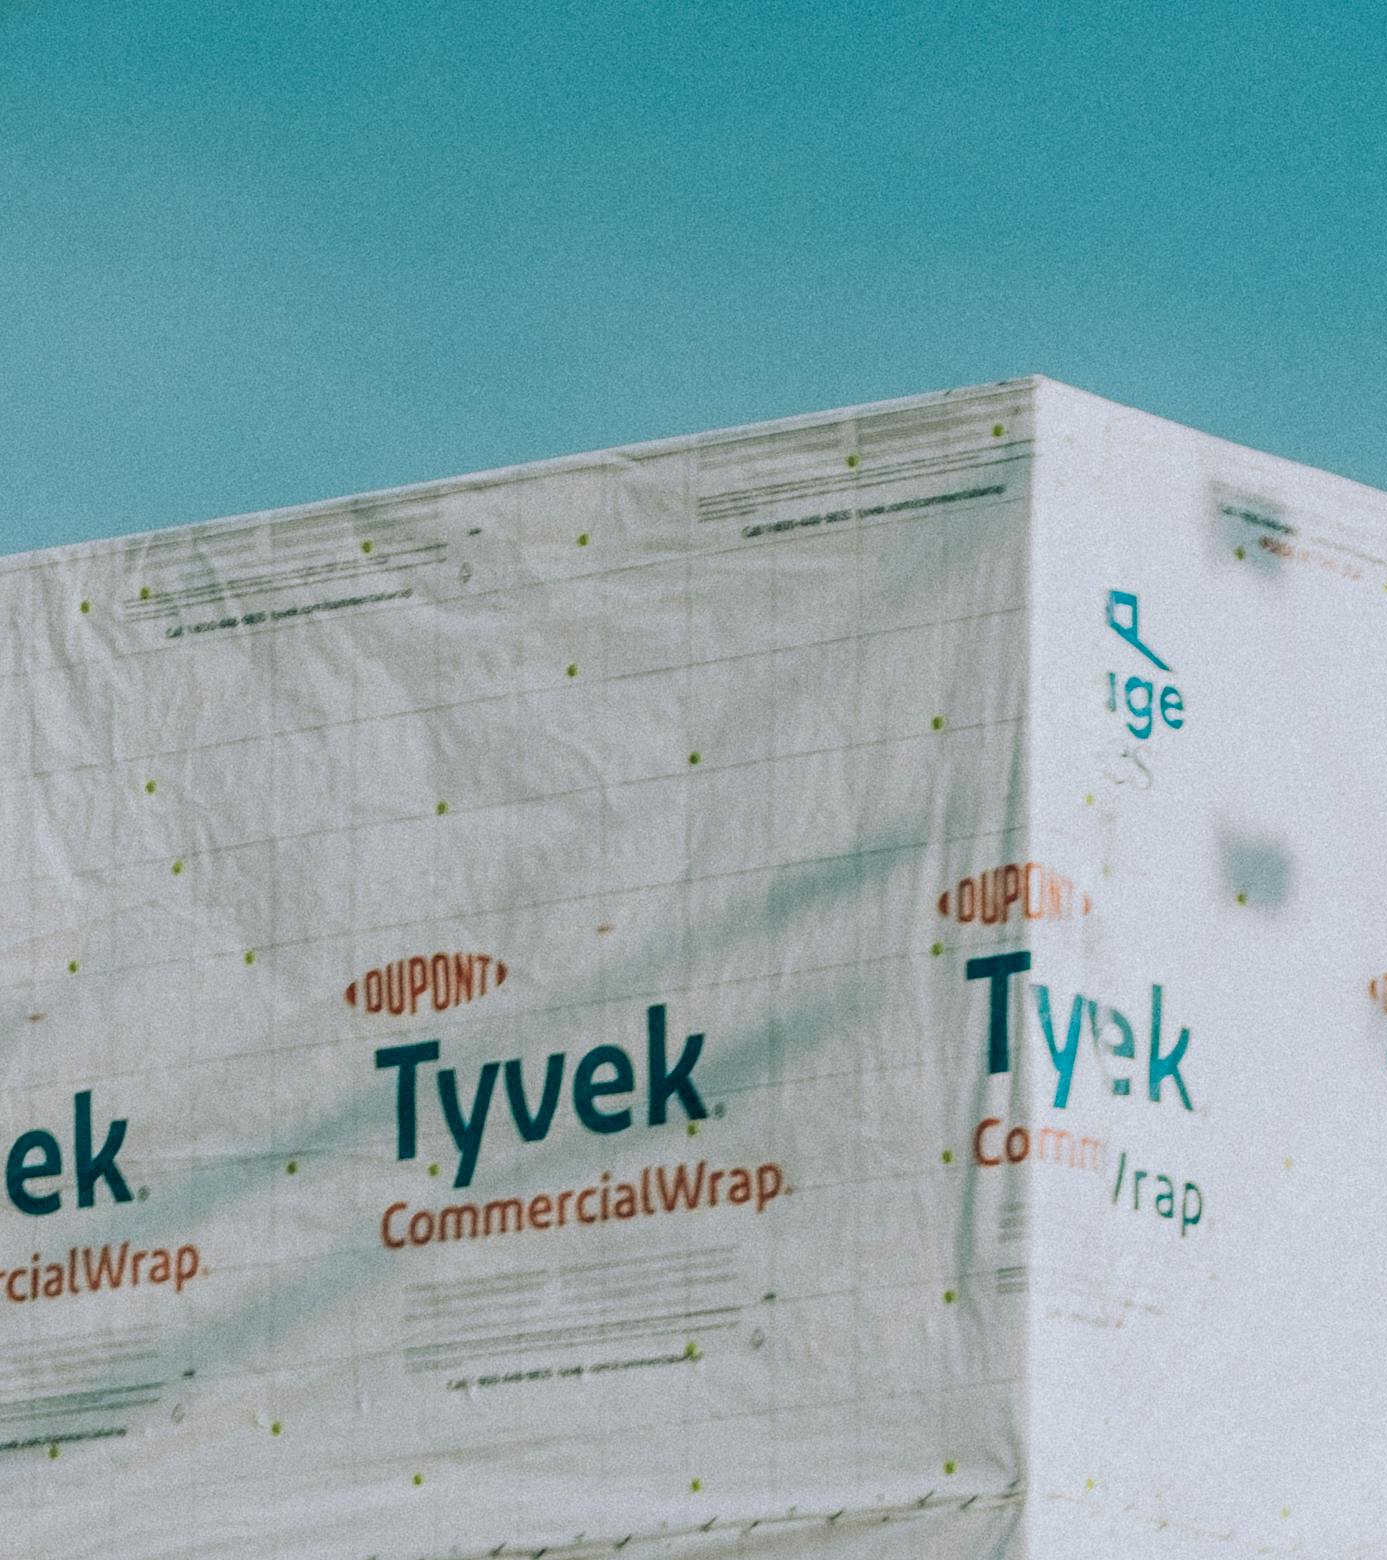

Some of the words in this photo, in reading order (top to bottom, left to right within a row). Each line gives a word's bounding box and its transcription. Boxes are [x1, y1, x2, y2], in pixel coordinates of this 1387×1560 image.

[364, 953, 493, 1016] DUPONT
[375, 1004, 707, 1188] Tyvek
[381, 1160, 784, 1250] CommercialWrap
